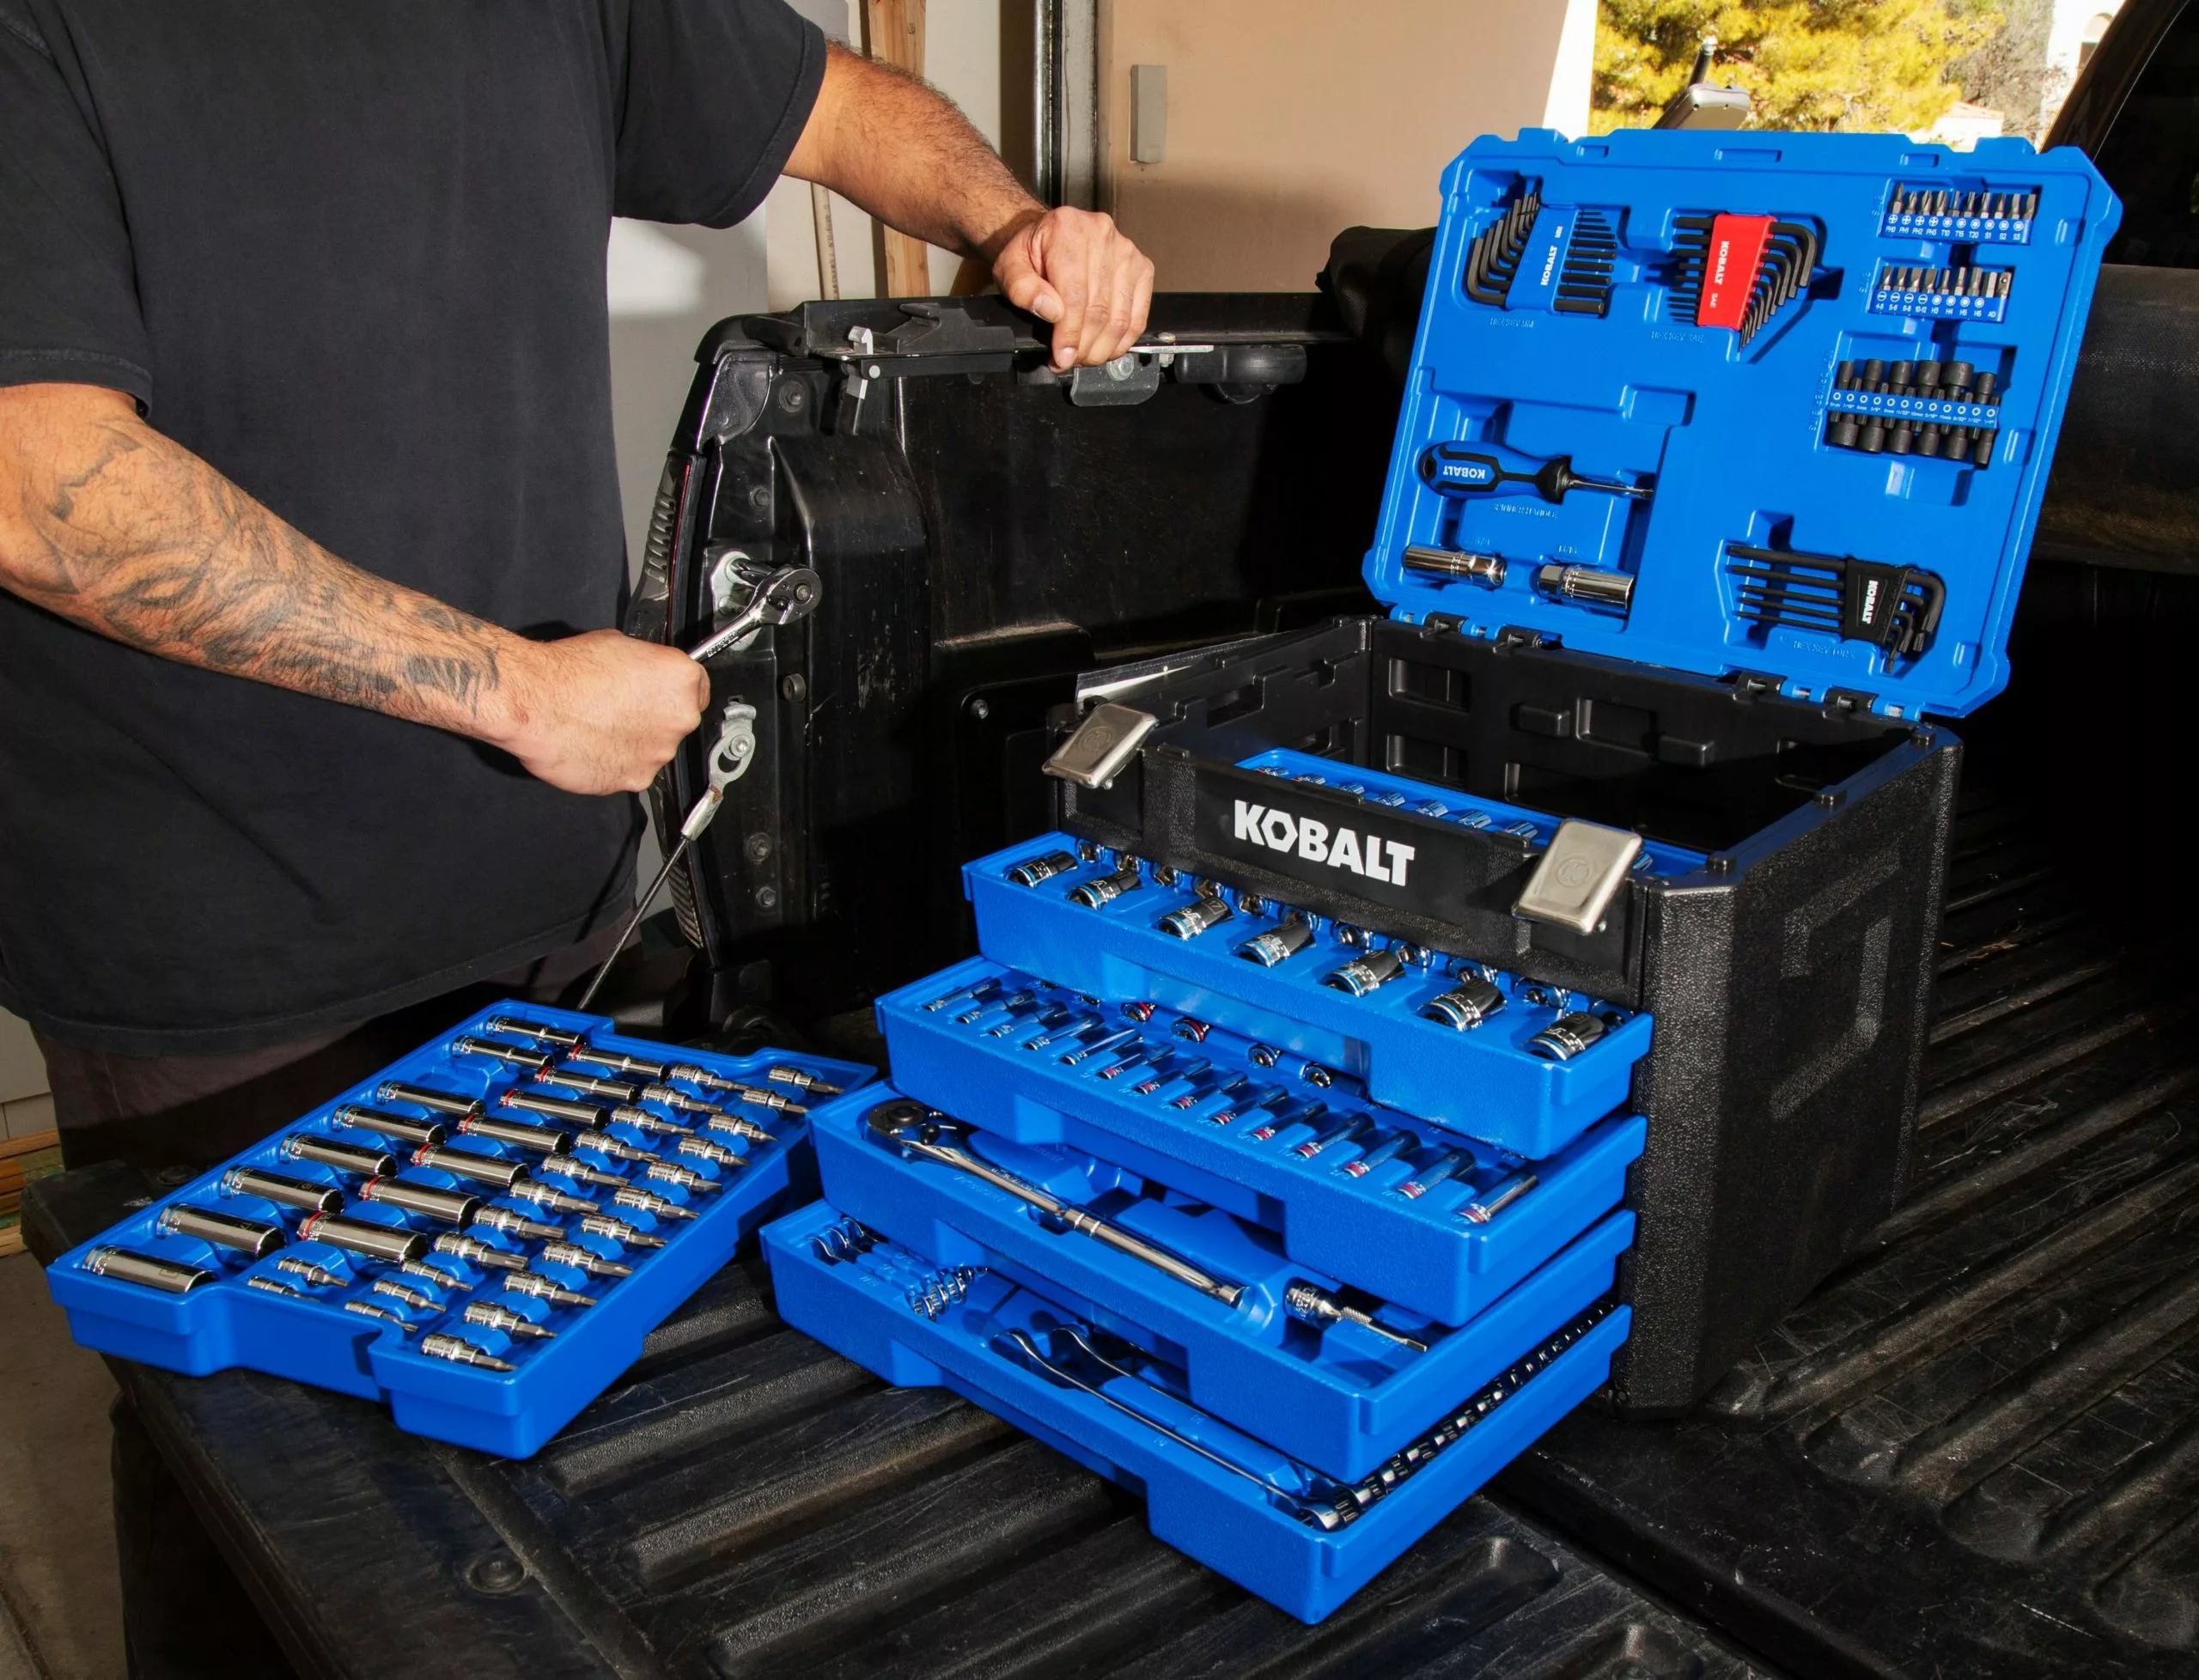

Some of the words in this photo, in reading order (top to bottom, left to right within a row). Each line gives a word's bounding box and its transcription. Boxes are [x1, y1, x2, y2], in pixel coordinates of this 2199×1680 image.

[1941, 228, 1951, 237] T10
[1969, 230, 1979, 239] T20
[1540, 245, 1557, 286] KOBALT
[1715, 240, 1729, 285] KOBALT
[1710, 293, 1719, 308] SAE
[1443, 465, 1486, 479] KOBALT
[1861, 580, 1879, 624] KOBALT
[1234, 800, 1416, 886] KOBALT
